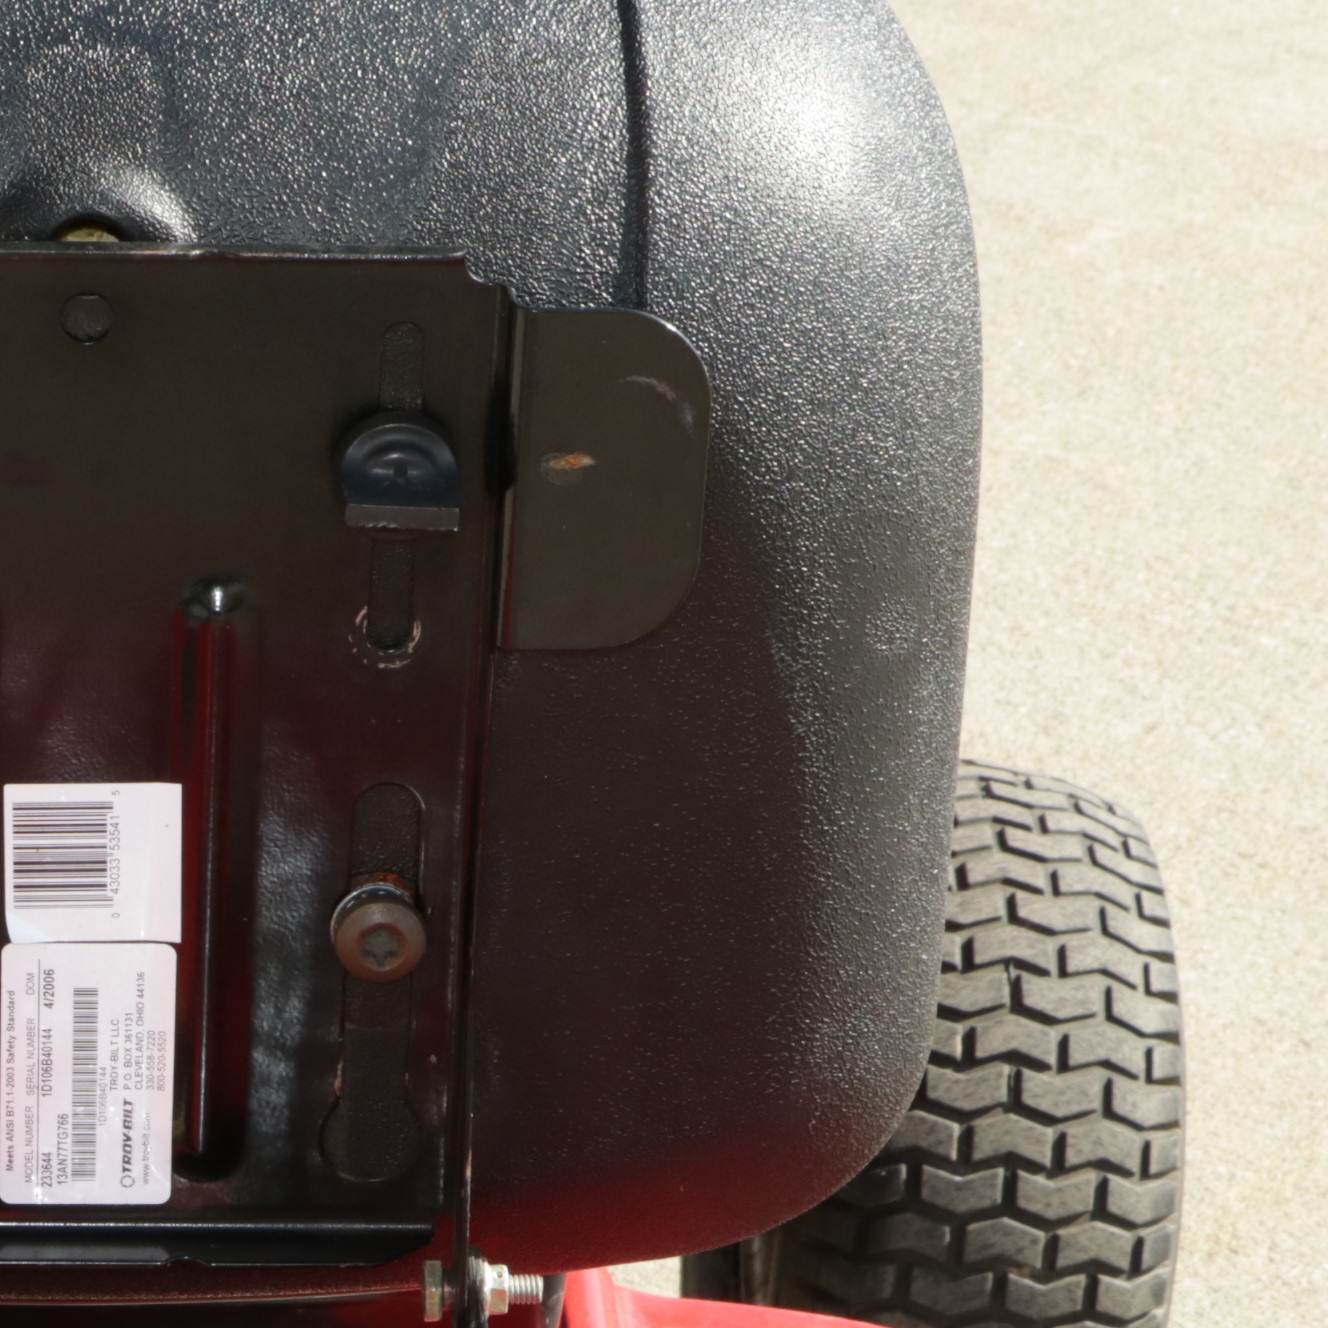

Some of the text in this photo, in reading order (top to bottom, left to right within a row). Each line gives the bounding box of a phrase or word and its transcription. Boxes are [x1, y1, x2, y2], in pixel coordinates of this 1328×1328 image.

[109, 814, 121, 851] 53541
[109, 857, 121, 895] 43033
[25, 972, 35, 996] DOM
[42, 968, 56, 1010] 4/2006
[135, 1001, 146, 1027] OHIO
[136, 971, 146, 999] 44136
[5, 990, 17, 1171] Meets ANSI B71.1-2003 Safety Standard
[25, 1017, 37, 1096] SERIAL NUMBER
[40, 1028, 54, 1098] 1D106B40144
[109, 1018, 121, 1092] TROY-BILT LLC
[123, 1011, 135, 1091] P.O. BOX 361131
[145, 1030, 157, 1091] 330-558-7220
[156, 1030, 168, 1092] 800-520-5520
[98, 1066, 107, 1127] 1D106B40144
[24, 1105, 35, 1184] MODEL NUMBER
[40, 1151, 53, 1188] 233644
[56, 1113, 69, 1186] 13AN77TG766
